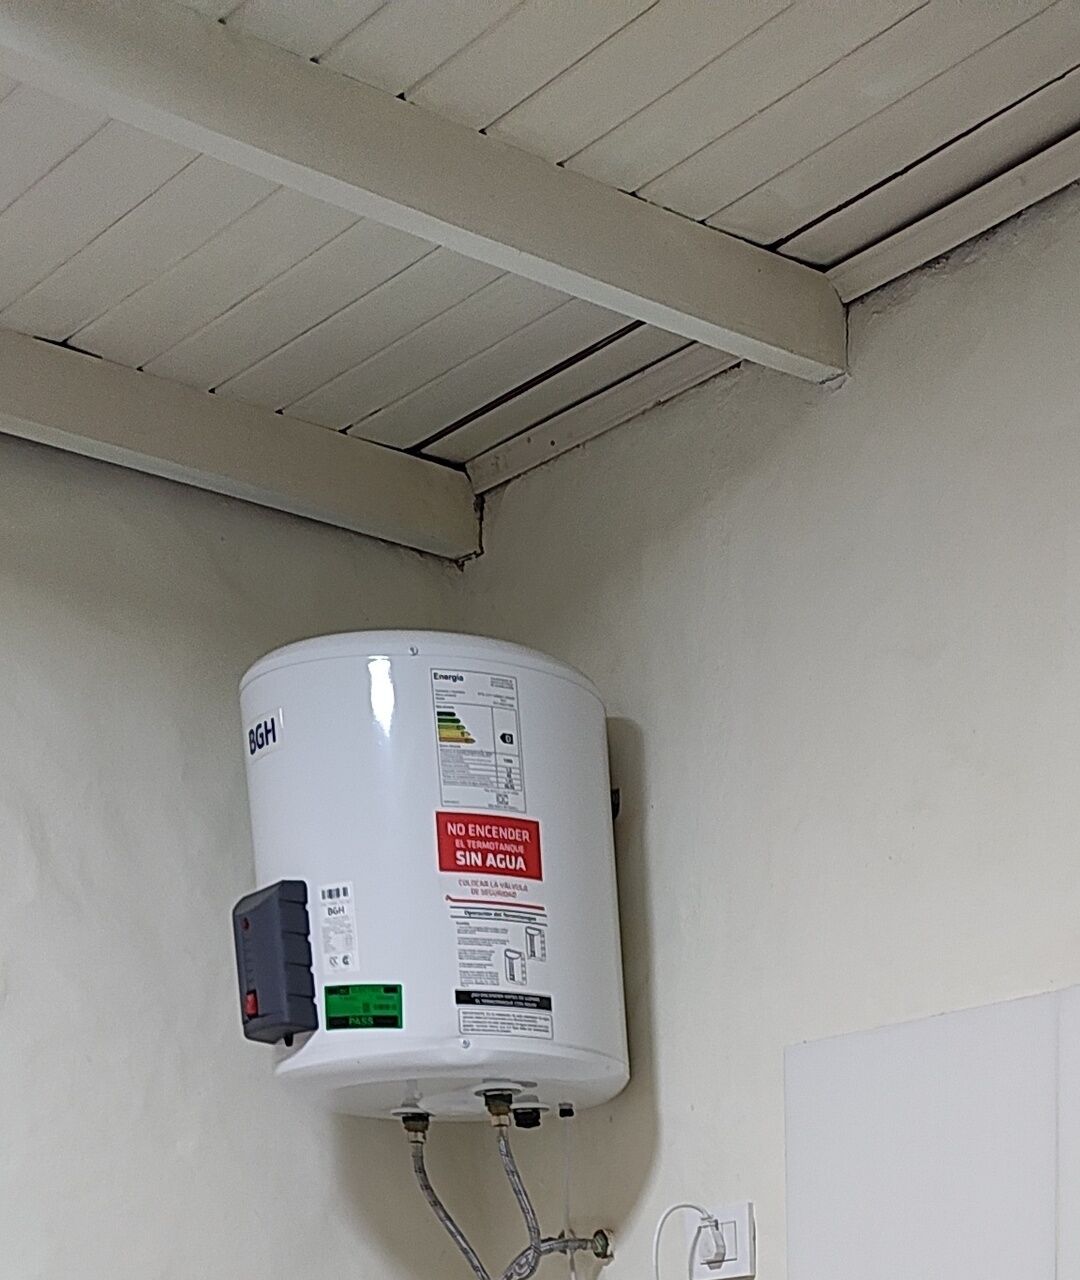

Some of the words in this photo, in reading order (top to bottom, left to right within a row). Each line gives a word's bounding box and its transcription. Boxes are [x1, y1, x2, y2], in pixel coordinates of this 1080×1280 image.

[249, 717, 276, 755] BGH
[447, 822, 466, 836] NO
[468, 823, 531, 842] ENCENDER
[455, 839, 466, 849] EL
[467, 840, 524, 854] TERMOTANQUE
[456, 850, 483, 867] SIN
[486, 853, 527, 871] AGUA
